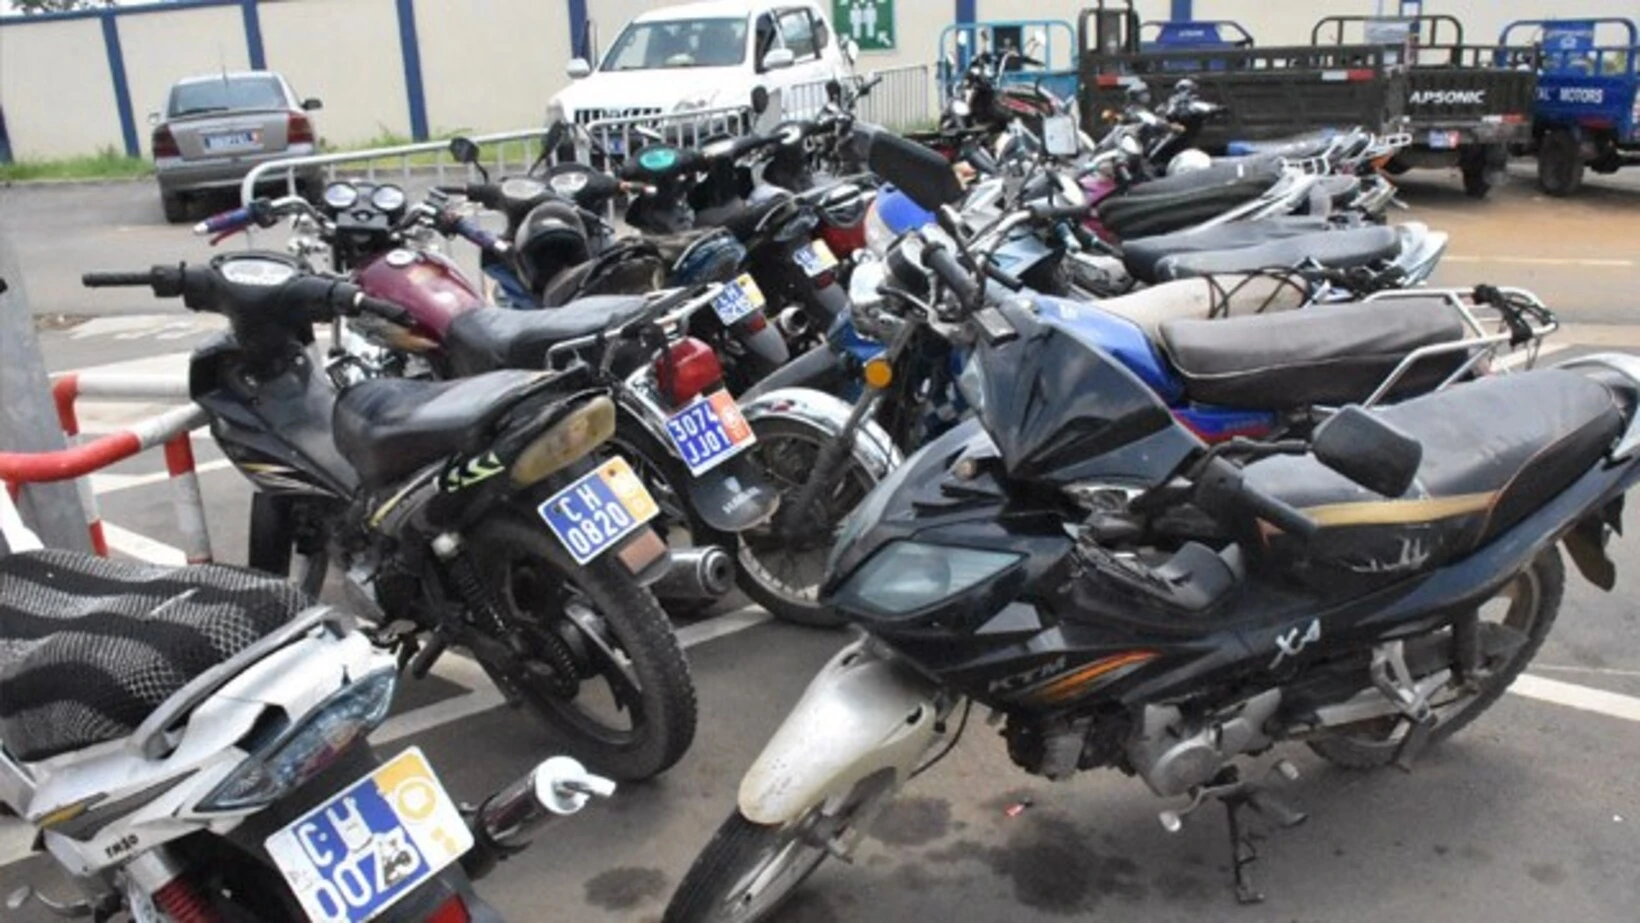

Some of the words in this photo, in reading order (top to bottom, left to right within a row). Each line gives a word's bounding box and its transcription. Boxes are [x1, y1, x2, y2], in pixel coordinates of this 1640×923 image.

[1408, 89, 1486, 104] APSONIC
[1559, 87, 1604, 104] MOTORS
[668, 402, 719, 443] 3074
[686, 424, 732, 465] JJ01
[567, 501, 630, 554] 0820
